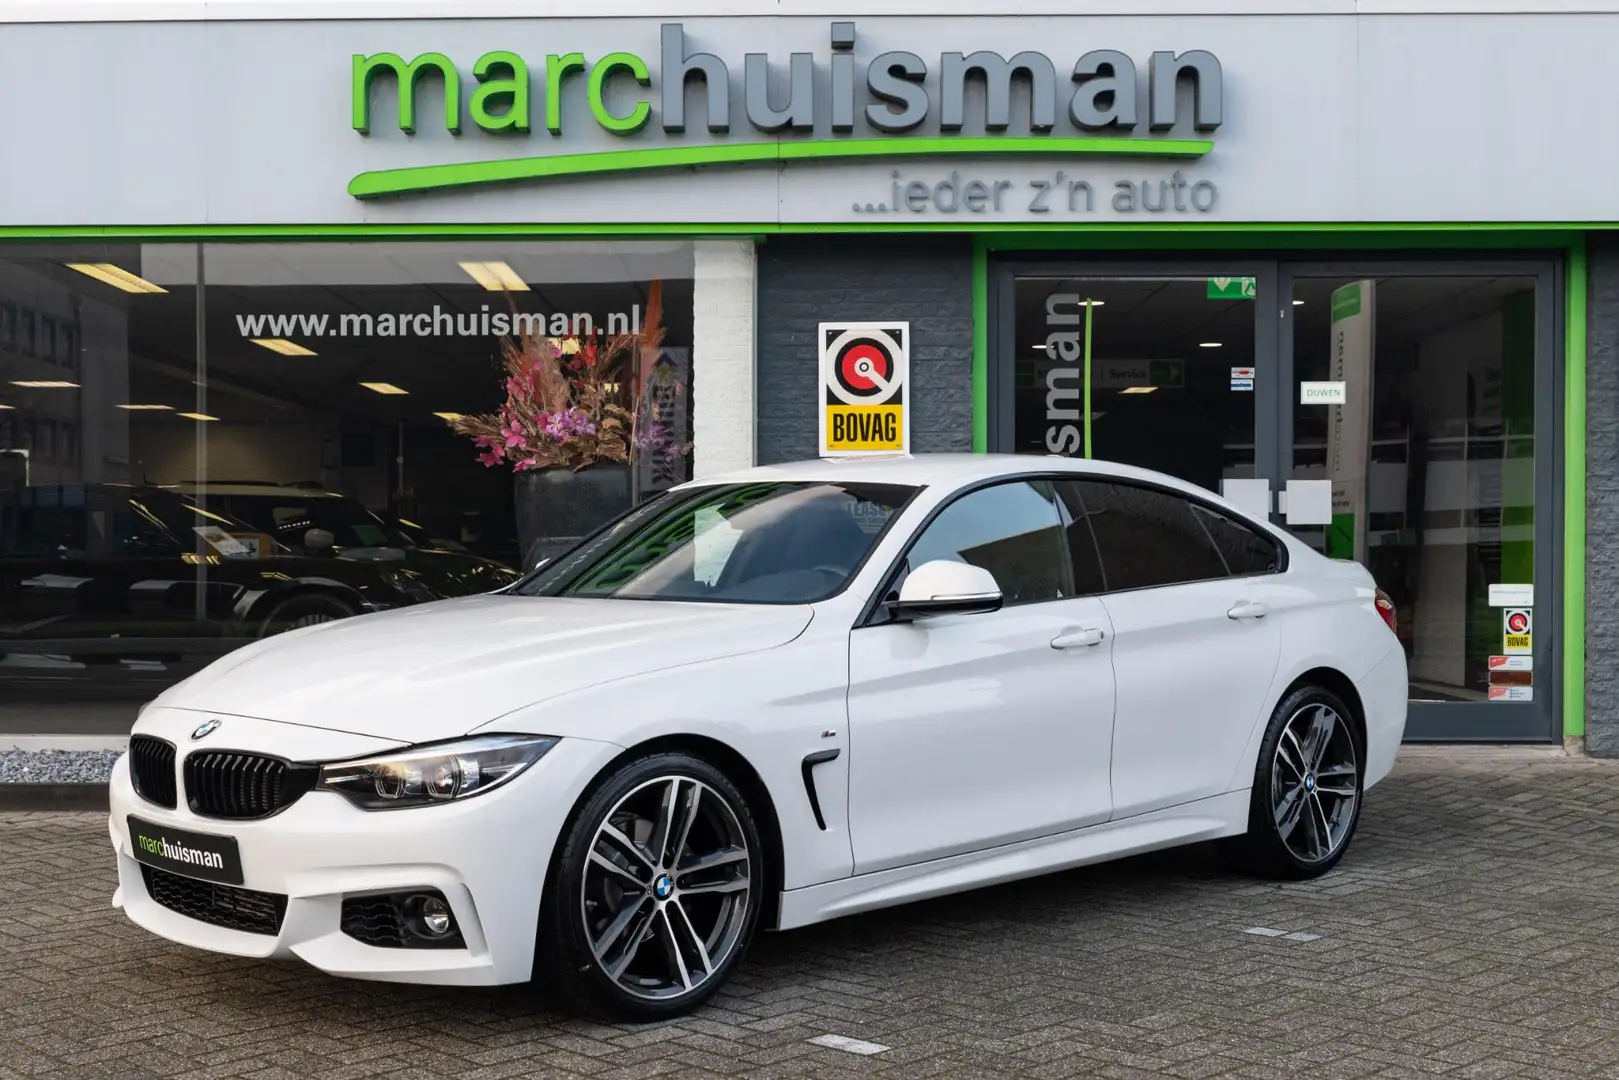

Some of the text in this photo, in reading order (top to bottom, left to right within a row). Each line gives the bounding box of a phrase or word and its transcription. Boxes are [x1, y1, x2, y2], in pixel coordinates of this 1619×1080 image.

[351, 22, 1222, 136] marchuisman
[1029, 170, 1093, 213] z'n
[1111, 170, 1219, 213] auto
[235, 304, 640, 337] www.marchuisman.nl
[1045, 293, 1081, 454] sman
[1306, 388, 1341, 398] DUWEN
[833, 412, 897, 442] BOVAG
[1507, 636, 1529, 647] BOVAG
[138, 834, 224, 869] marchuisman
